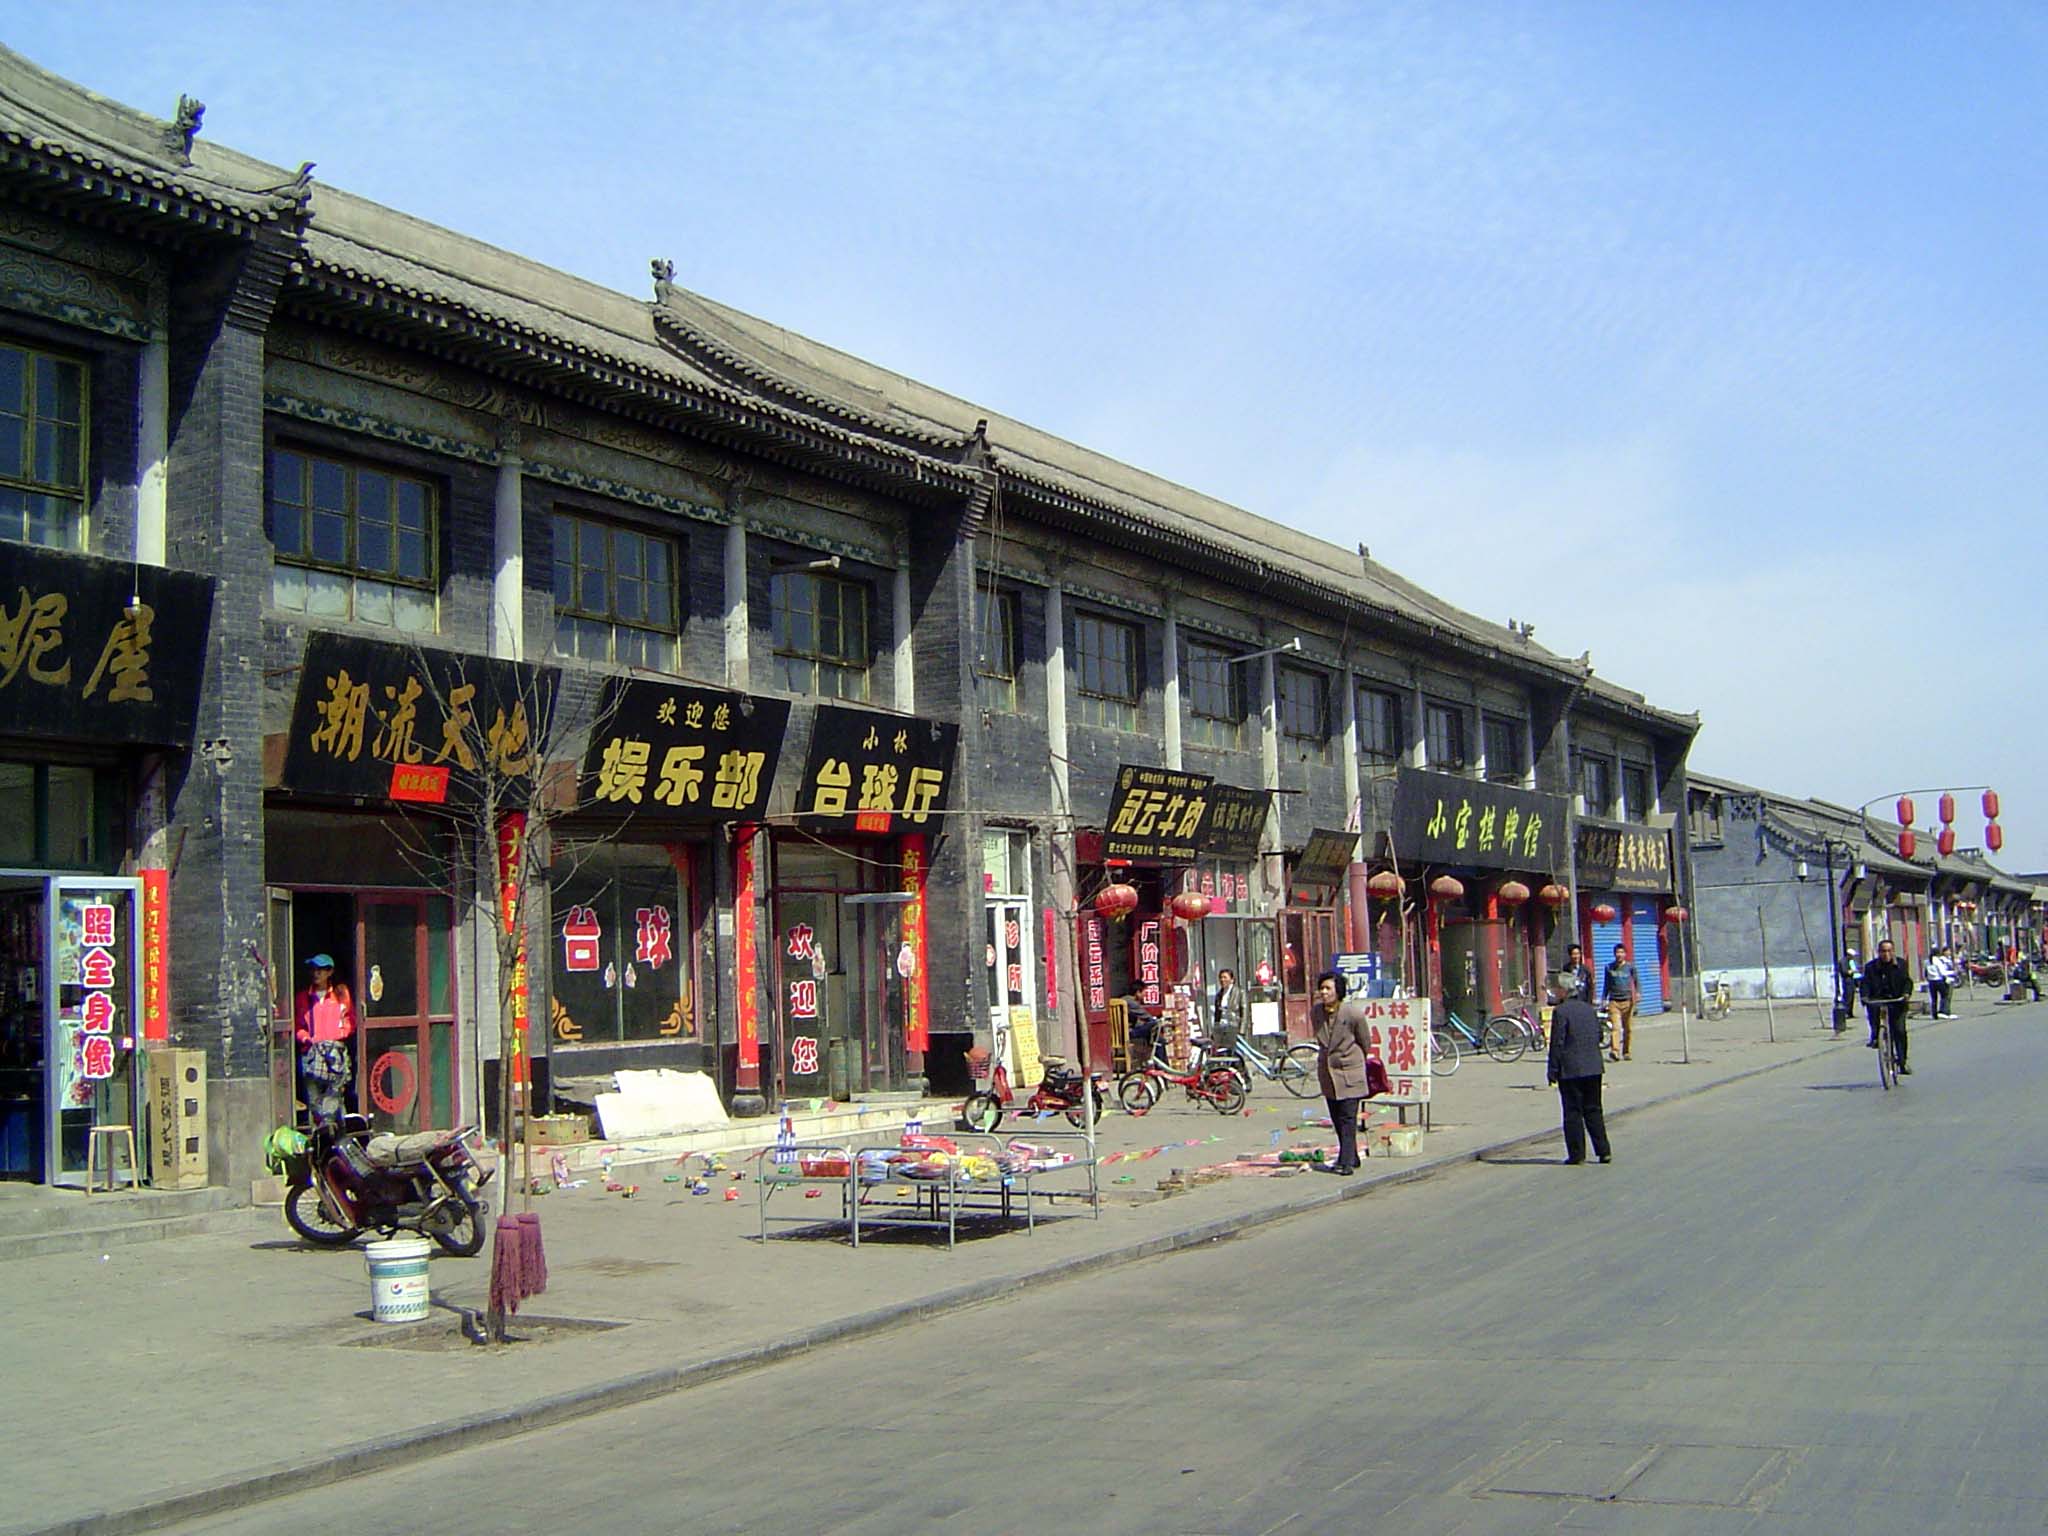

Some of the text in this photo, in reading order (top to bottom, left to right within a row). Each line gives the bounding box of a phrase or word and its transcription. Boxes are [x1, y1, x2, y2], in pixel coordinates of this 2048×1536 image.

[311, 669, 534, 776] 潮流天地
[656, 697, 731, 731] 欢迎您
[863, 726, 908, 754] 小林
[595, 737, 766, 810] 娱乐部
[814, 758, 944, 823] 台球厅
[1111, 788, 1207, 839] 冠云牛肉
[1427, 799, 1543, 857] 小宝棋牌馆
[562, 904, 673, 971] 台球
[1005, 920, 1023, 992] 诊所
[1141, 922, 1160, 1004] 厂价直销
[82, 904, 116, 1079] 照全身像
[787, 922, 819, 1075] 欢迎您
[1364, 1002, 1409, 1019] 小林
